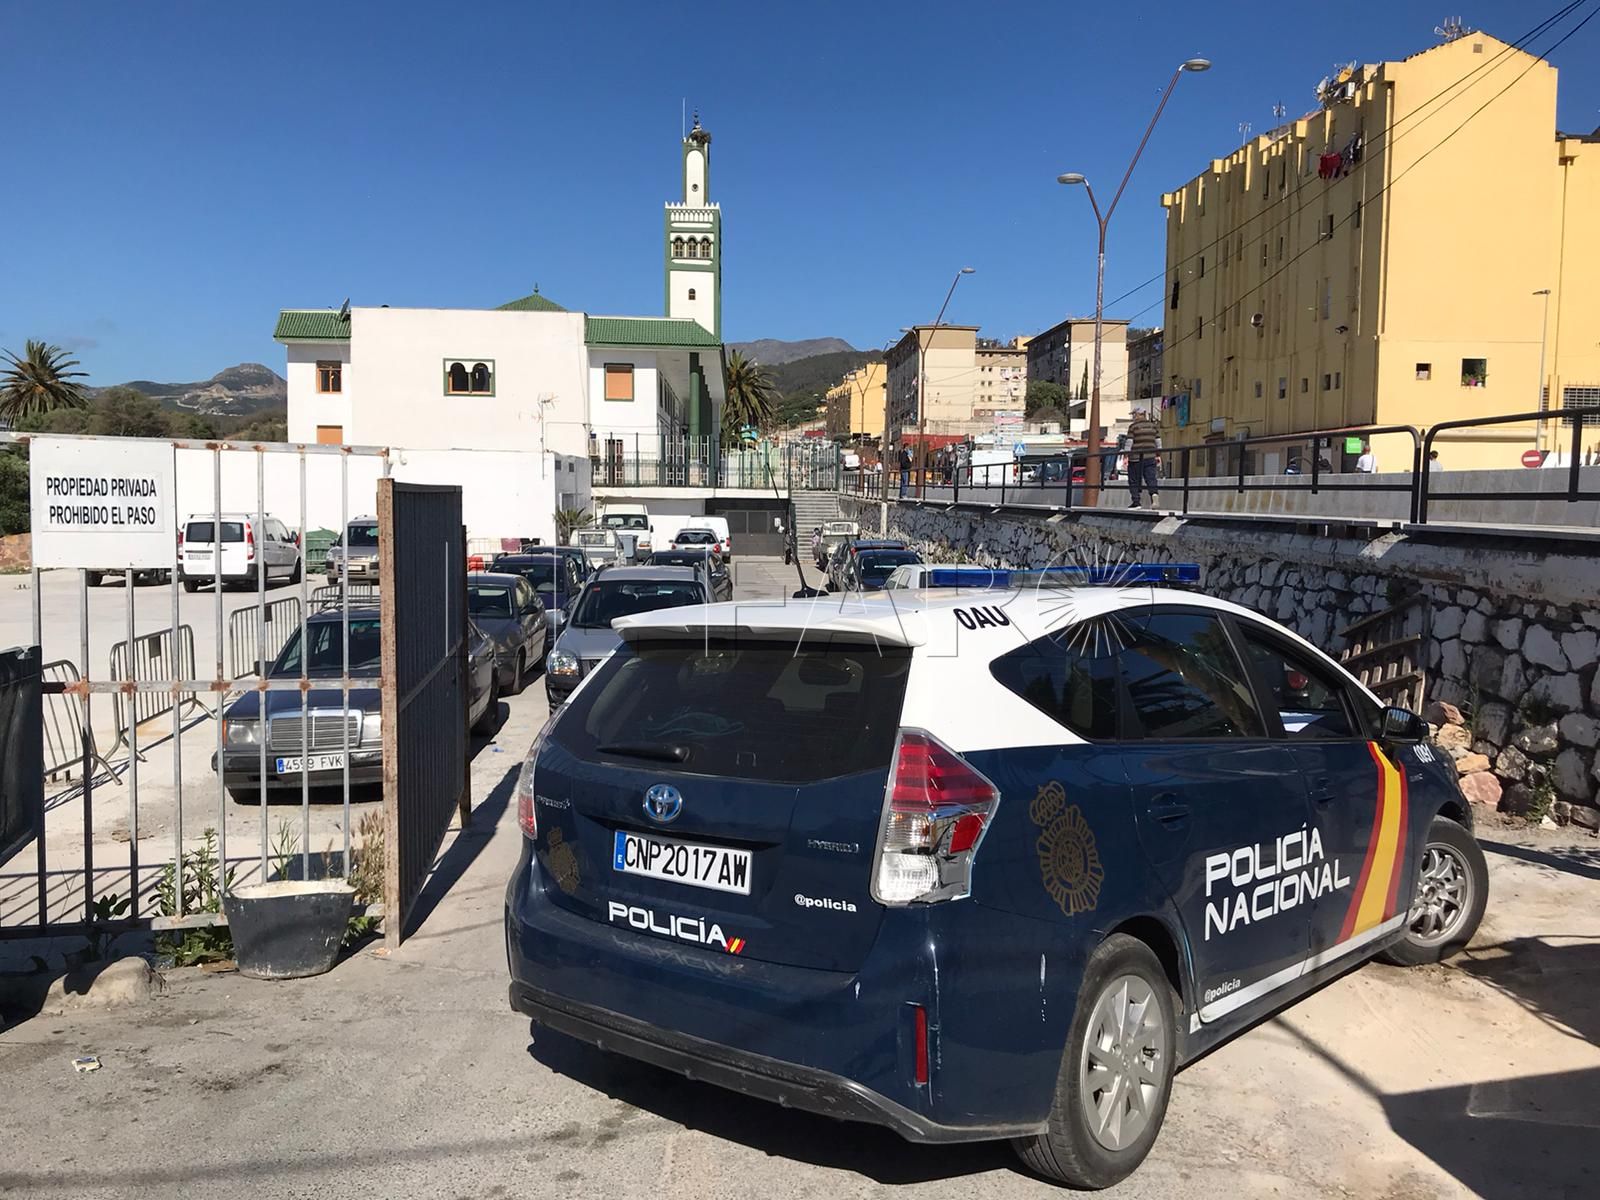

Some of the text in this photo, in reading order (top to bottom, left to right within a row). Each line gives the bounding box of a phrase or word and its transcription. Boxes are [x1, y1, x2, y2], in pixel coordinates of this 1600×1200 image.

[46, 477, 157, 497] PROPIEDAD PRIVADA
[49, 505, 156, 525] PROHIBIDO EL PASO
[320, 755, 343, 769] FVK
[617, 837, 748, 888] E CNP2017AW
[1205, 822, 1325, 897] POLICÍA
[794, 893, 857, 913] @policia
[1205, 858, 1351, 941] NACIONAL
[608, 900, 728, 948] POLICÍA
[1204, 978, 1241, 1003] @policia
